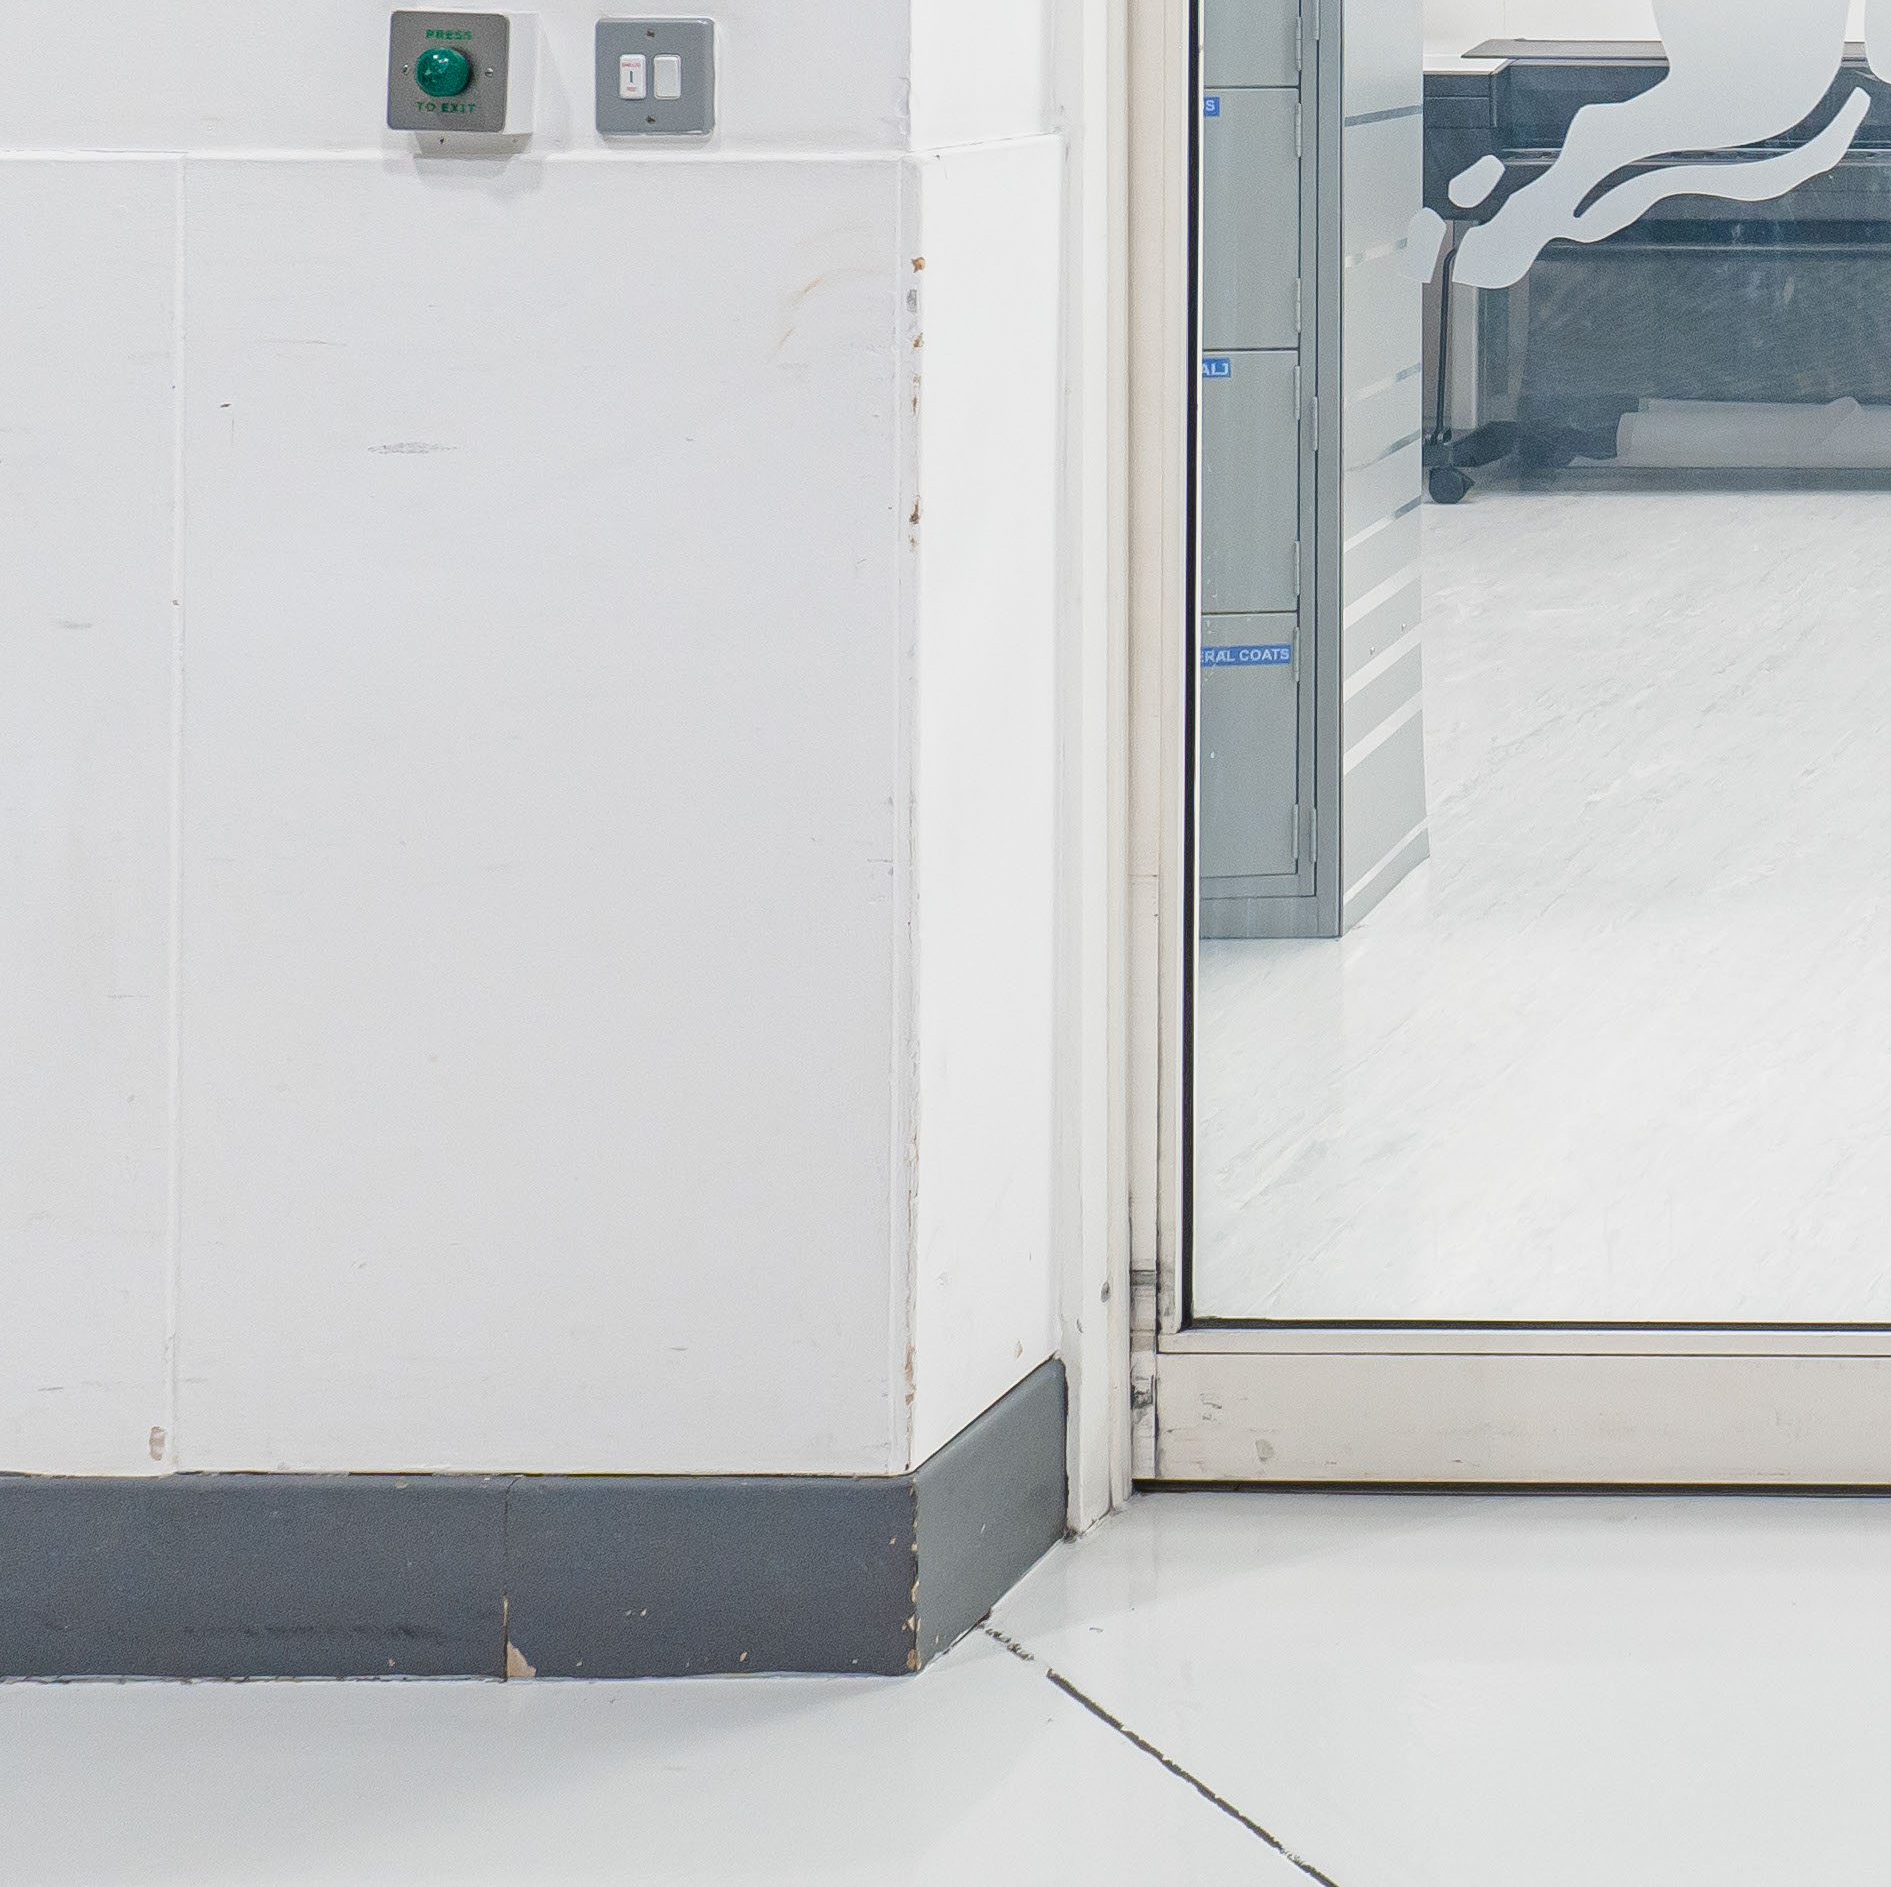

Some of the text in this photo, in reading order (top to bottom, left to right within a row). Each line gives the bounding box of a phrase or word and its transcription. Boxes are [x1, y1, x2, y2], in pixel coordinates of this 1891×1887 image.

[425, 29, 473, 40] PRESS
[416, 101, 476, 114] TO EXIT
[1201, 648, 1290, 663] RAL COATS
